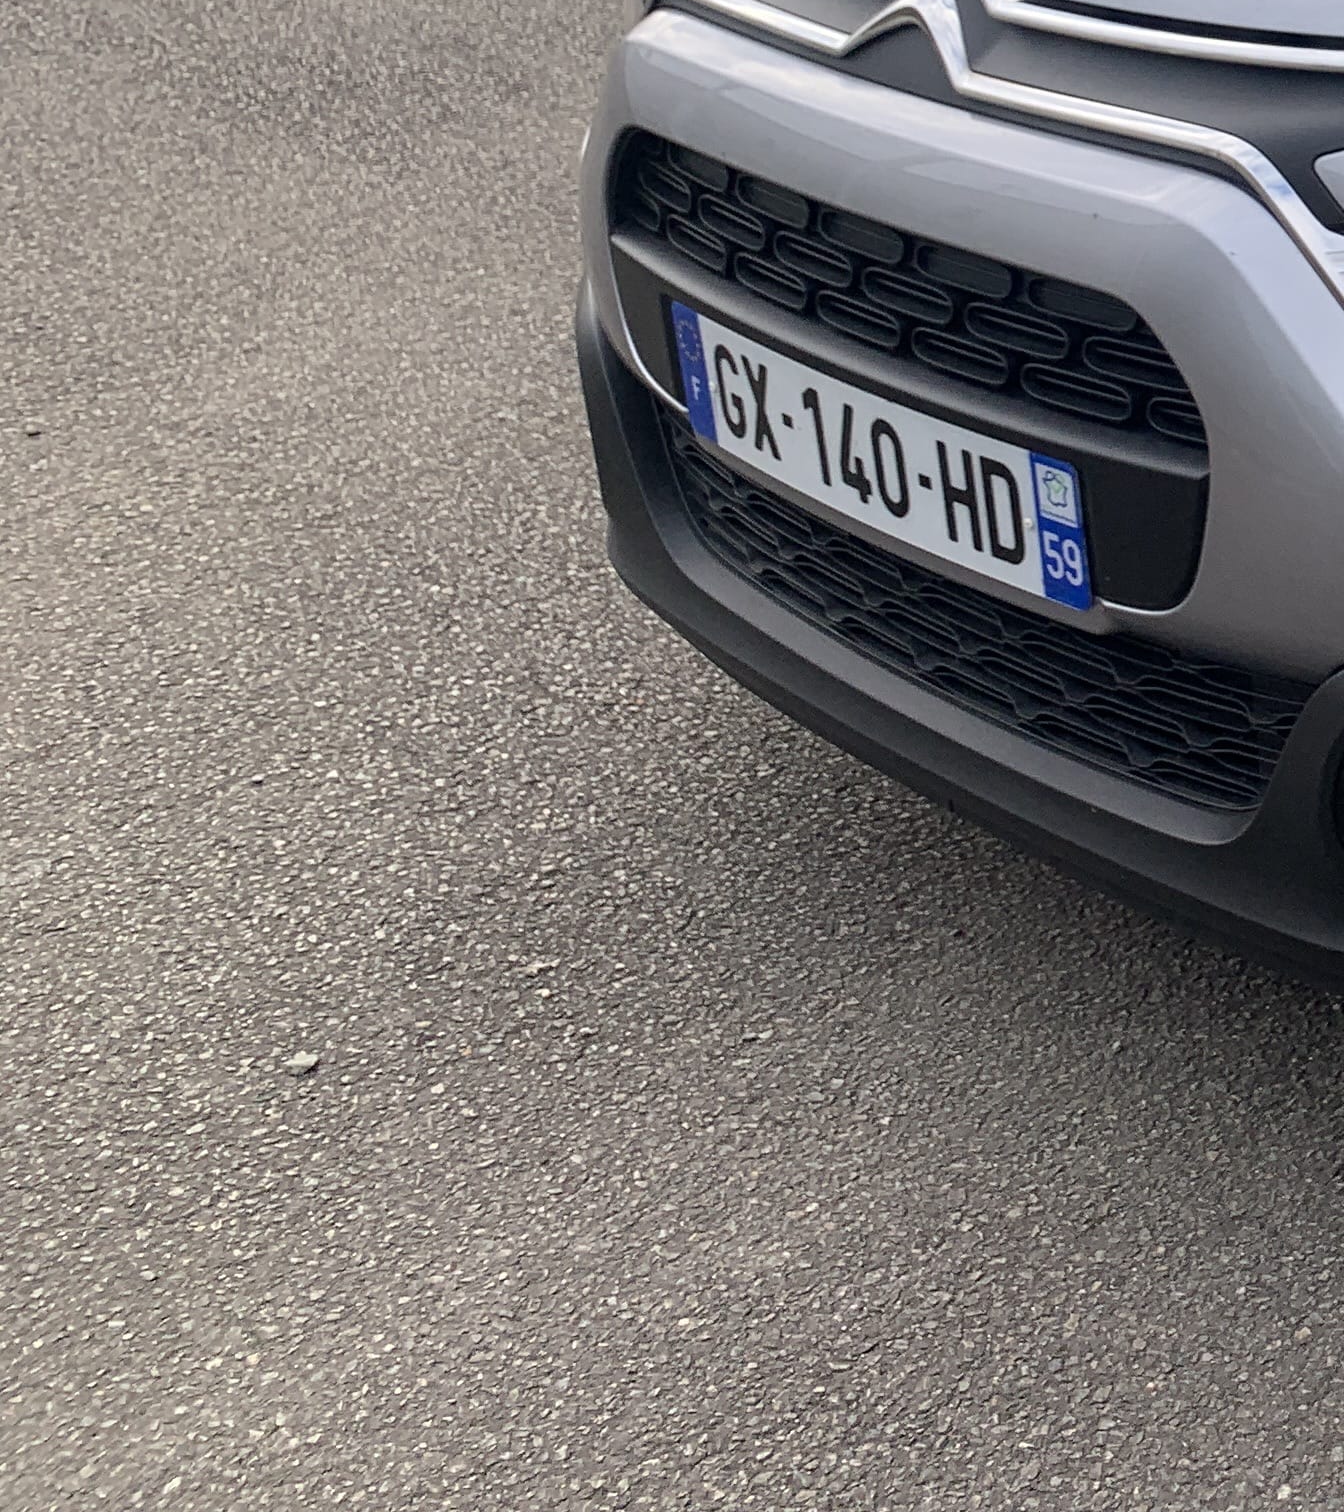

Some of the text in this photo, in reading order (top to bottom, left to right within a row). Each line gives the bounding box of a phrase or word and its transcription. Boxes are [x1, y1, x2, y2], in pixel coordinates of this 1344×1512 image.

[686, 343, 1084, 587] F GX-140-HD 59
